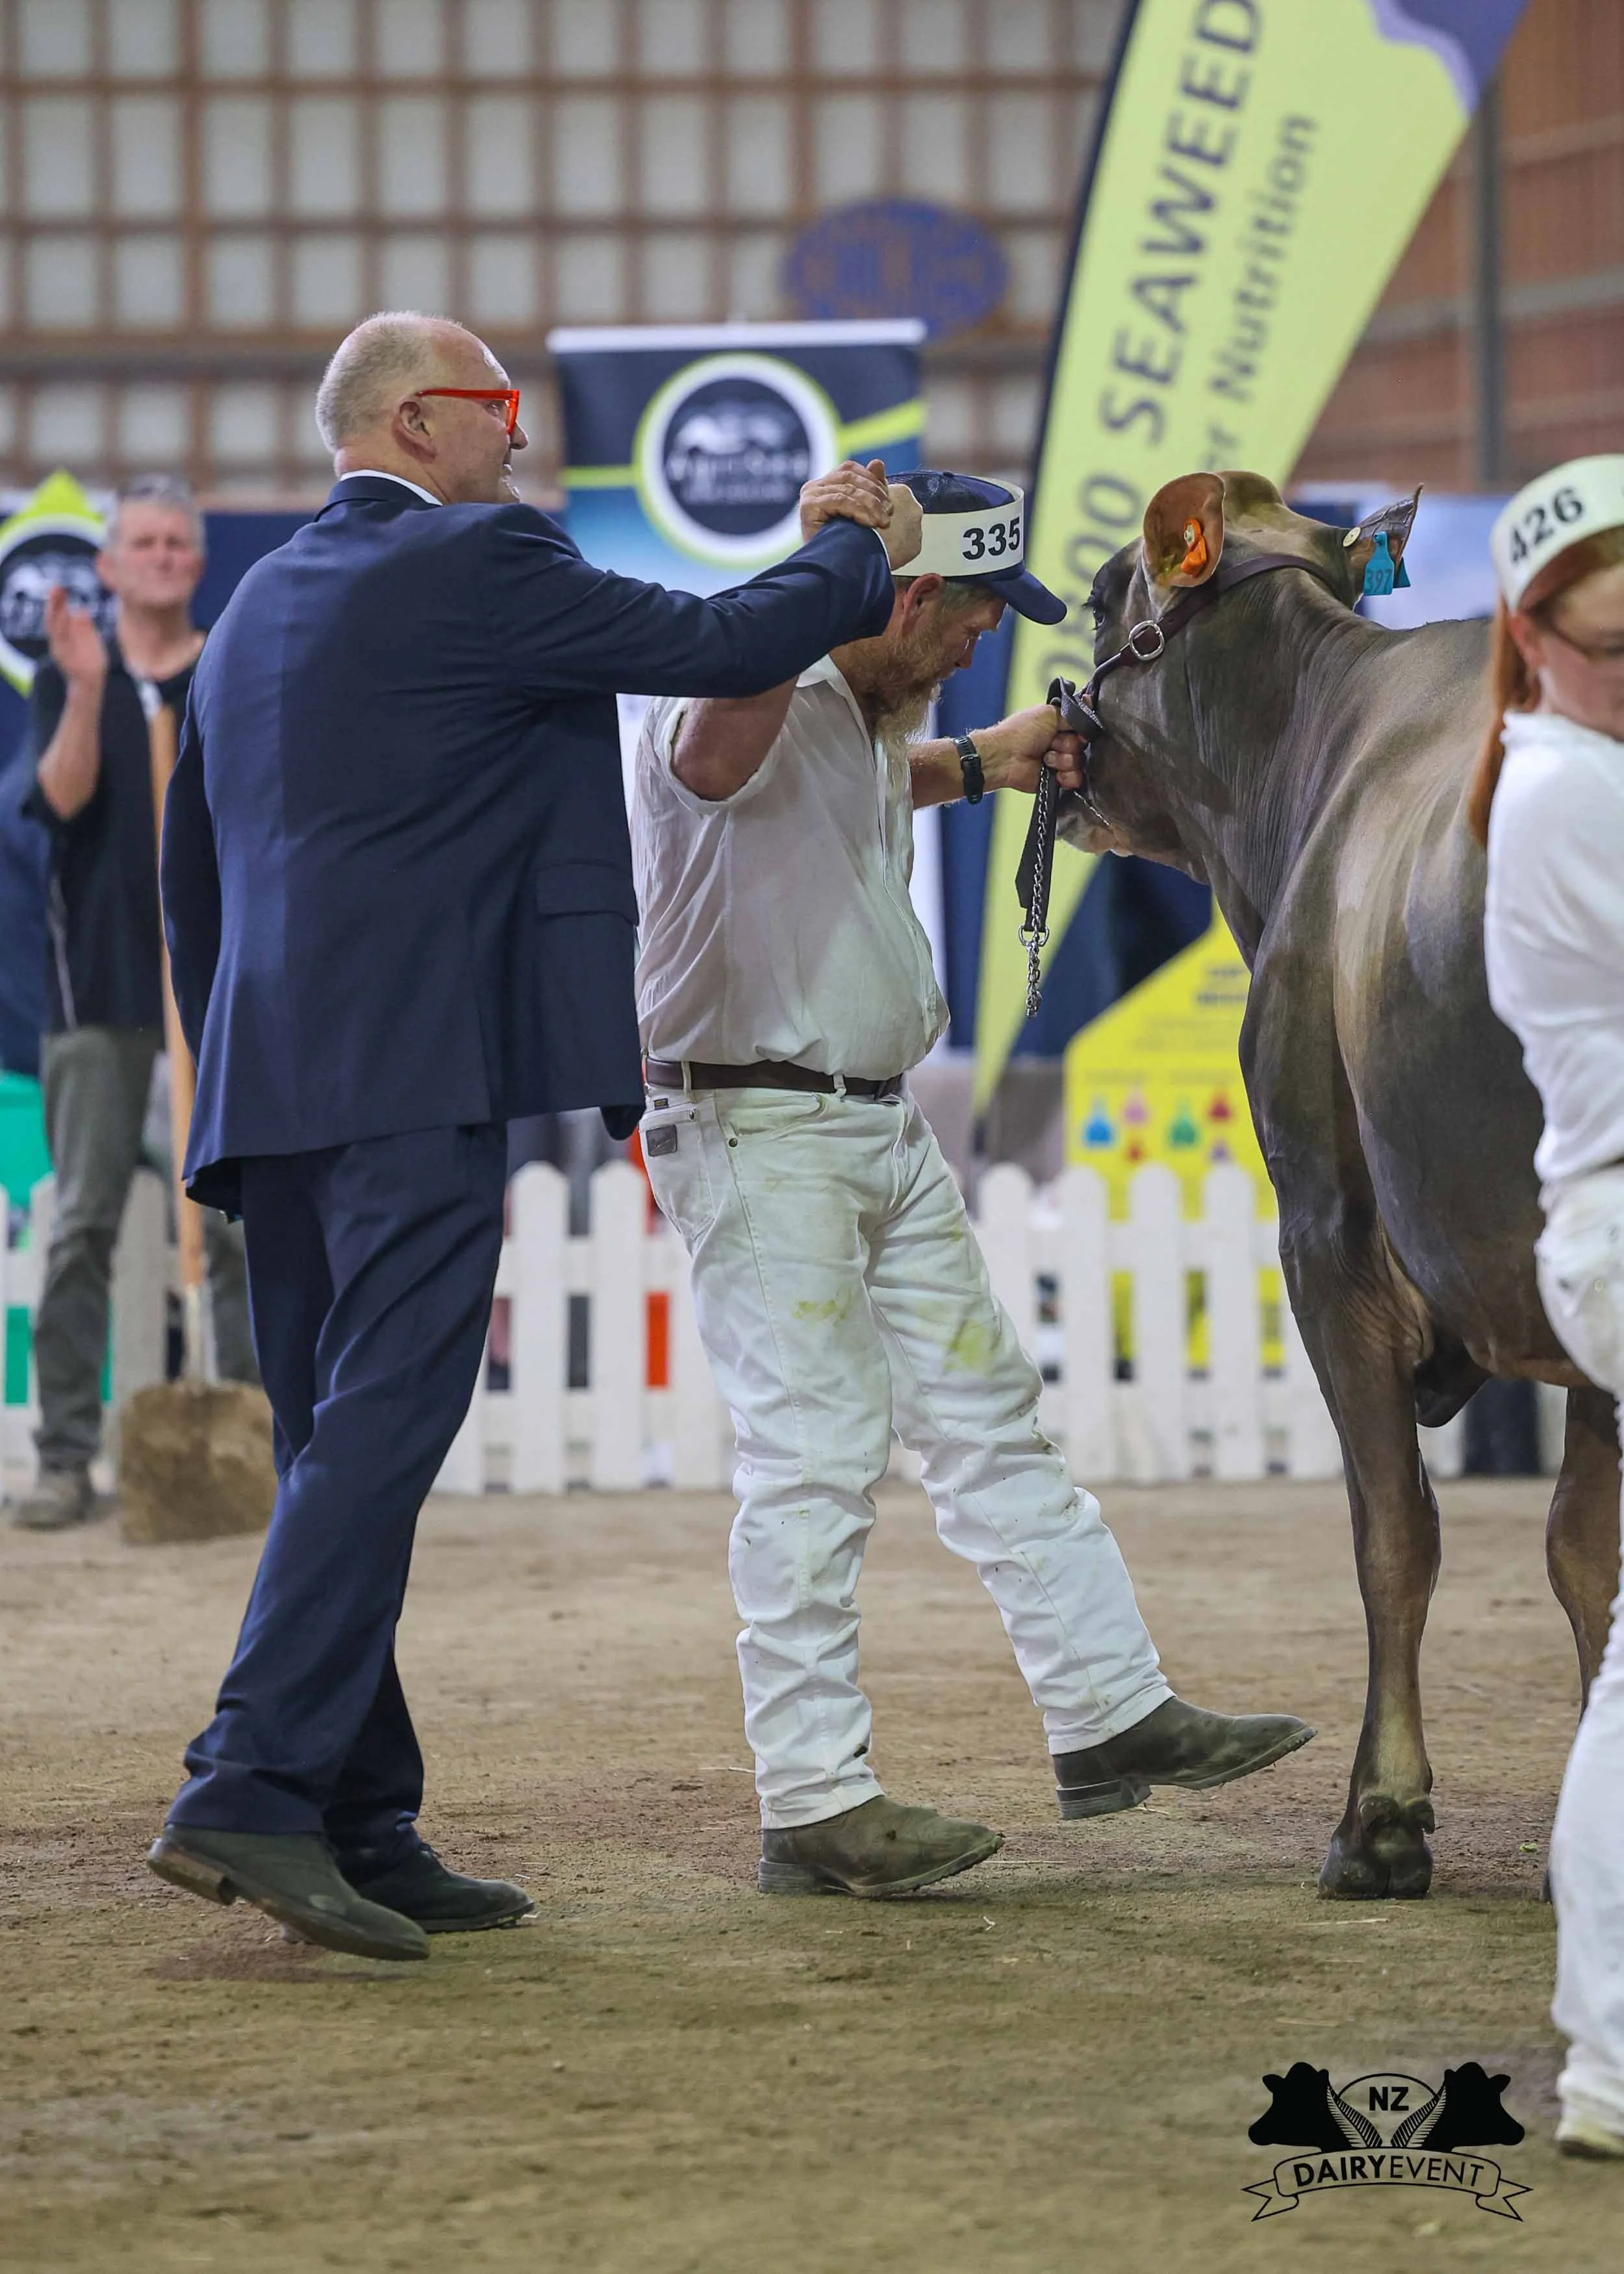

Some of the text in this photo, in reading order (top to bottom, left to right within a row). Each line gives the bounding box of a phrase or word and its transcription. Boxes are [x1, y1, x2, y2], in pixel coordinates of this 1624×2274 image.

[1098, 0, 1263, 449] SEAWEED
[1208, 115, 1318, 402] Nutrition
[961, 516, 1021, 560] 335
[1510, 485, 1584, 561] 426
